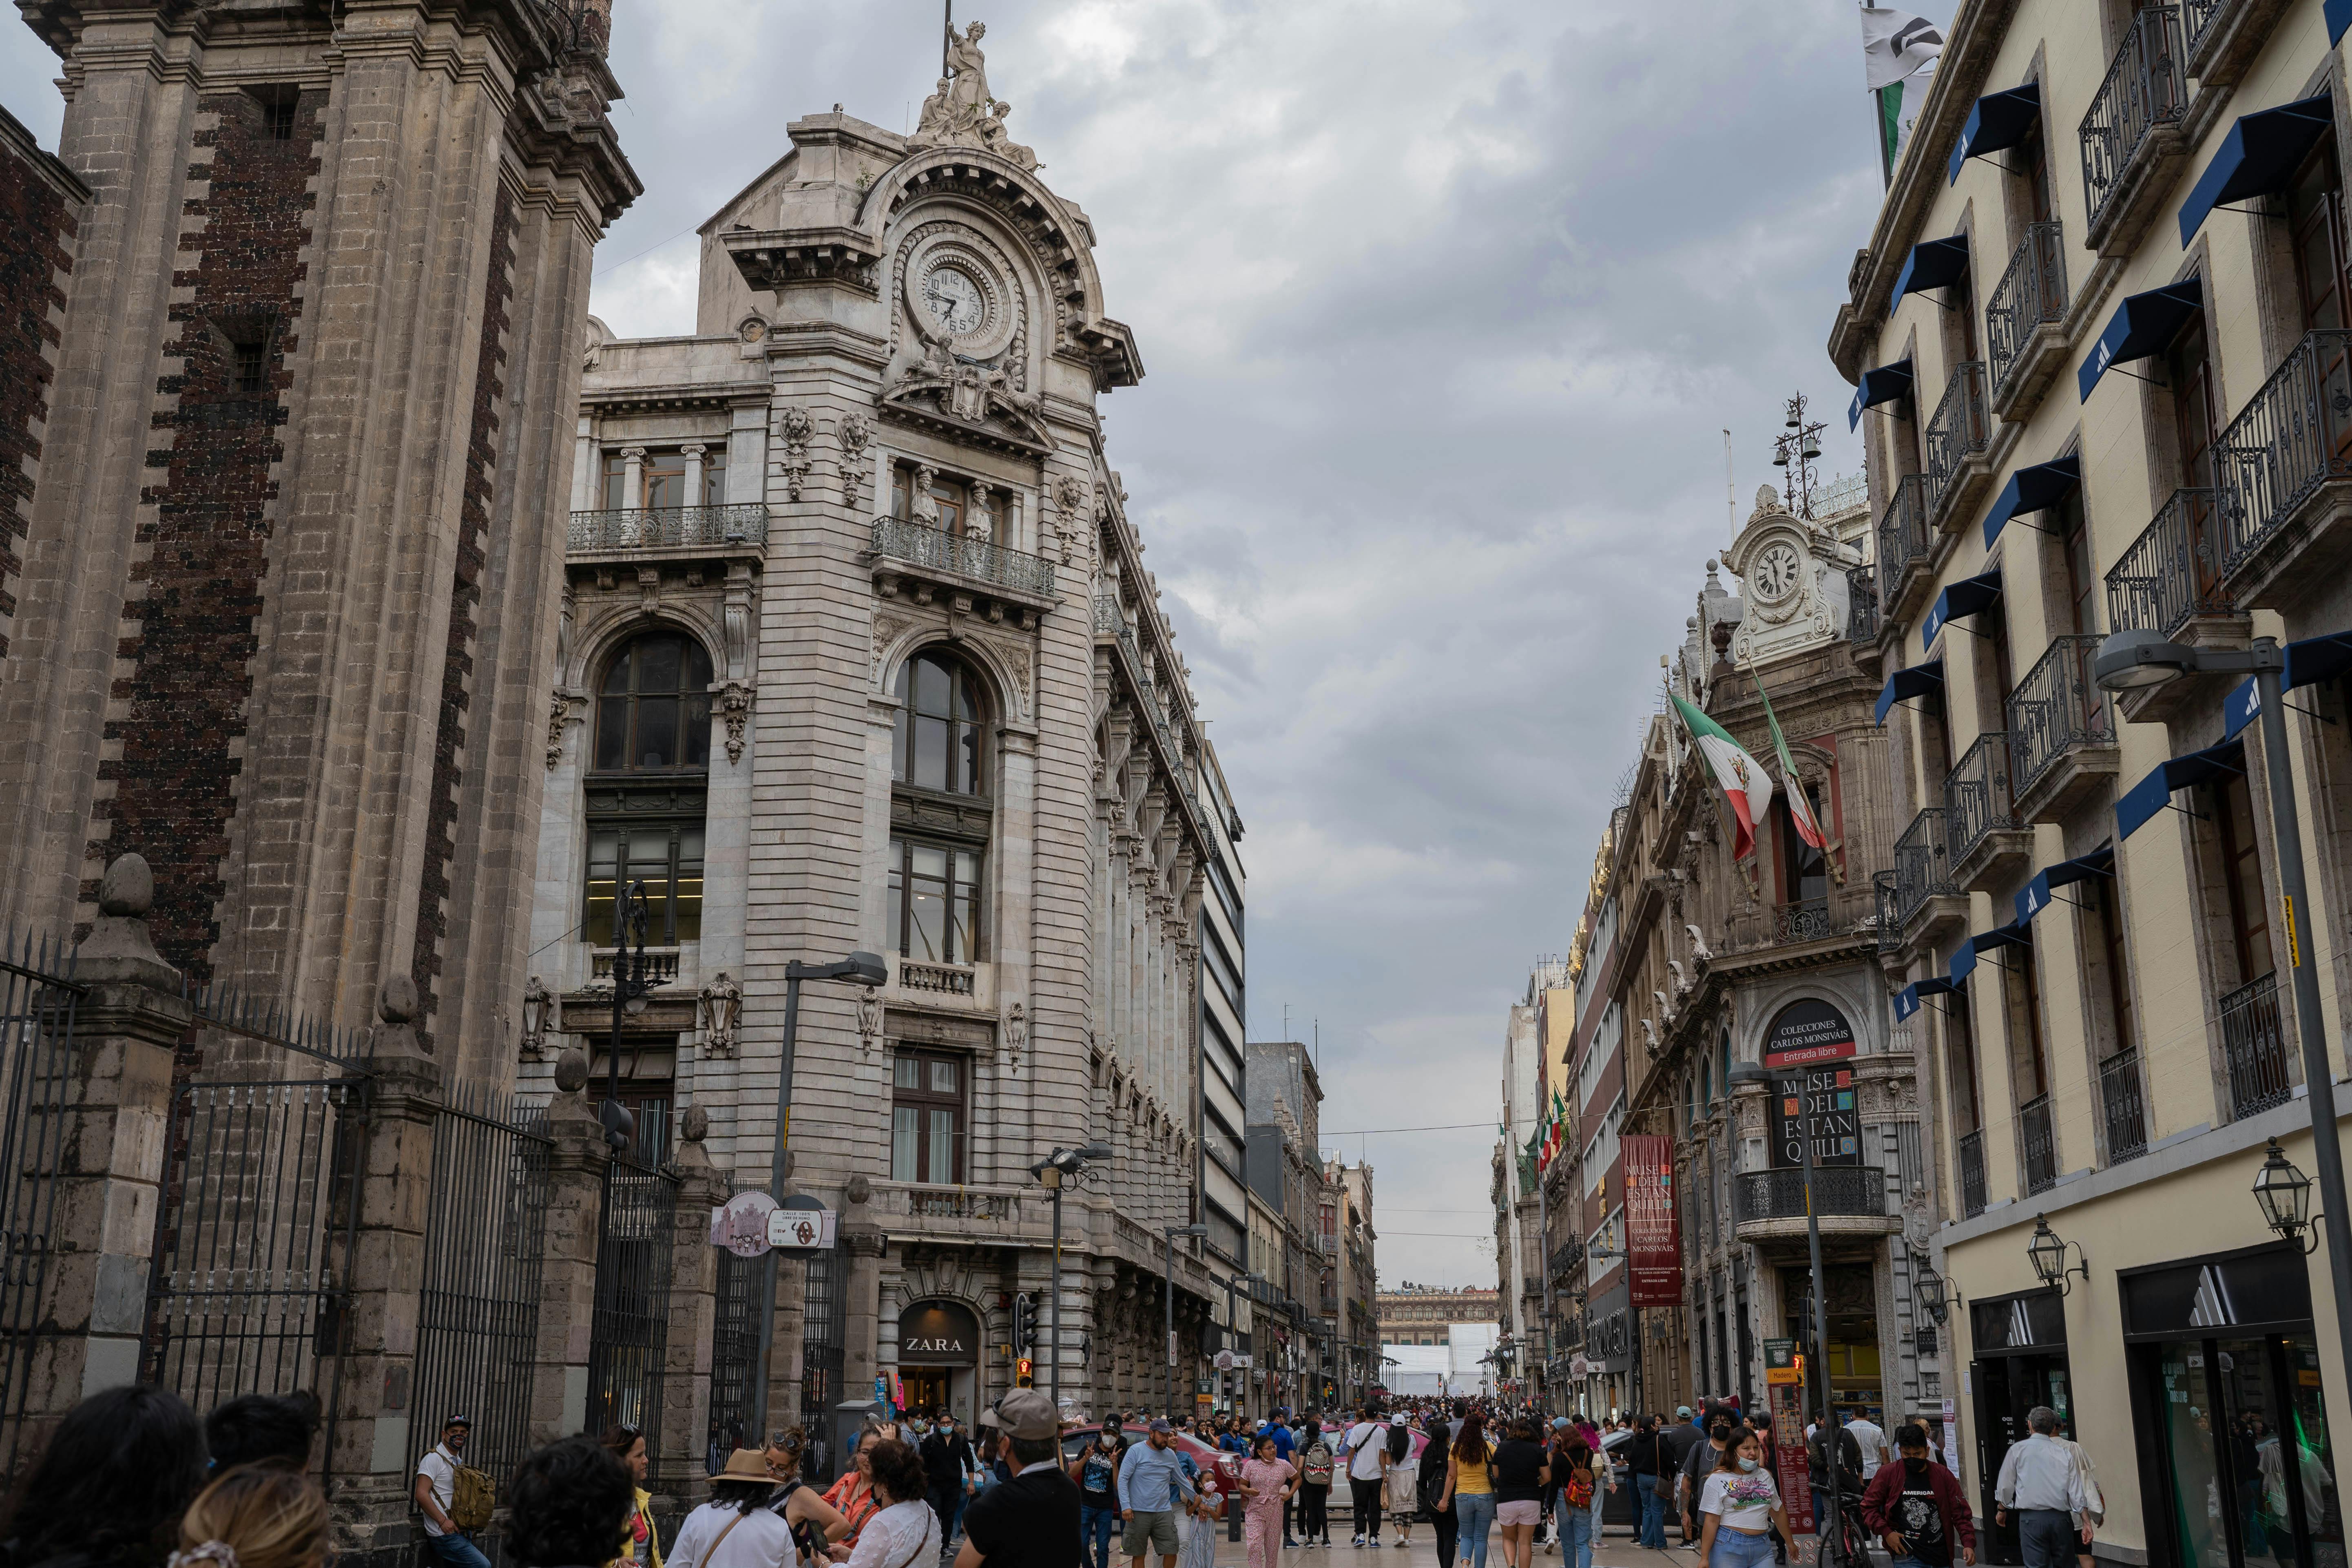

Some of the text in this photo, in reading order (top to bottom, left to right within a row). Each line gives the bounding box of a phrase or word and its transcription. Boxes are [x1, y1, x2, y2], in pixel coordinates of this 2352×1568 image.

[932, 278, 939, 290] 10
[941, 274, 947, 285] 11
[950, 273, 958, 285] 12
[962, 281, 965, 291] 1
[969, 291, 976, 302] 2
[931, 302, 937, 313] 8
[973, 304, 979, 315] 3
[949, 320, 956, 332] 6
[960, 319, 966, 330] 5
[968, 315, 975, 326] 4
[1781, 1020, 1835, 1035] COLECCIONES
[1771, 1029, 1848, 1048] CARLOS MONSIVÁIS
[1784, 1048, 1837, 1061] Entrada libre
[1638, 1177, 1661, 1186] DEL
[1627, 1188, 1671, 1198] ESTAN
[1628, 1199, 1663, 1211] QUILL
[1633, 1244, 1674, 1252] MONSIVÁIS
[906, 1338, 964, 1351] ZARA
